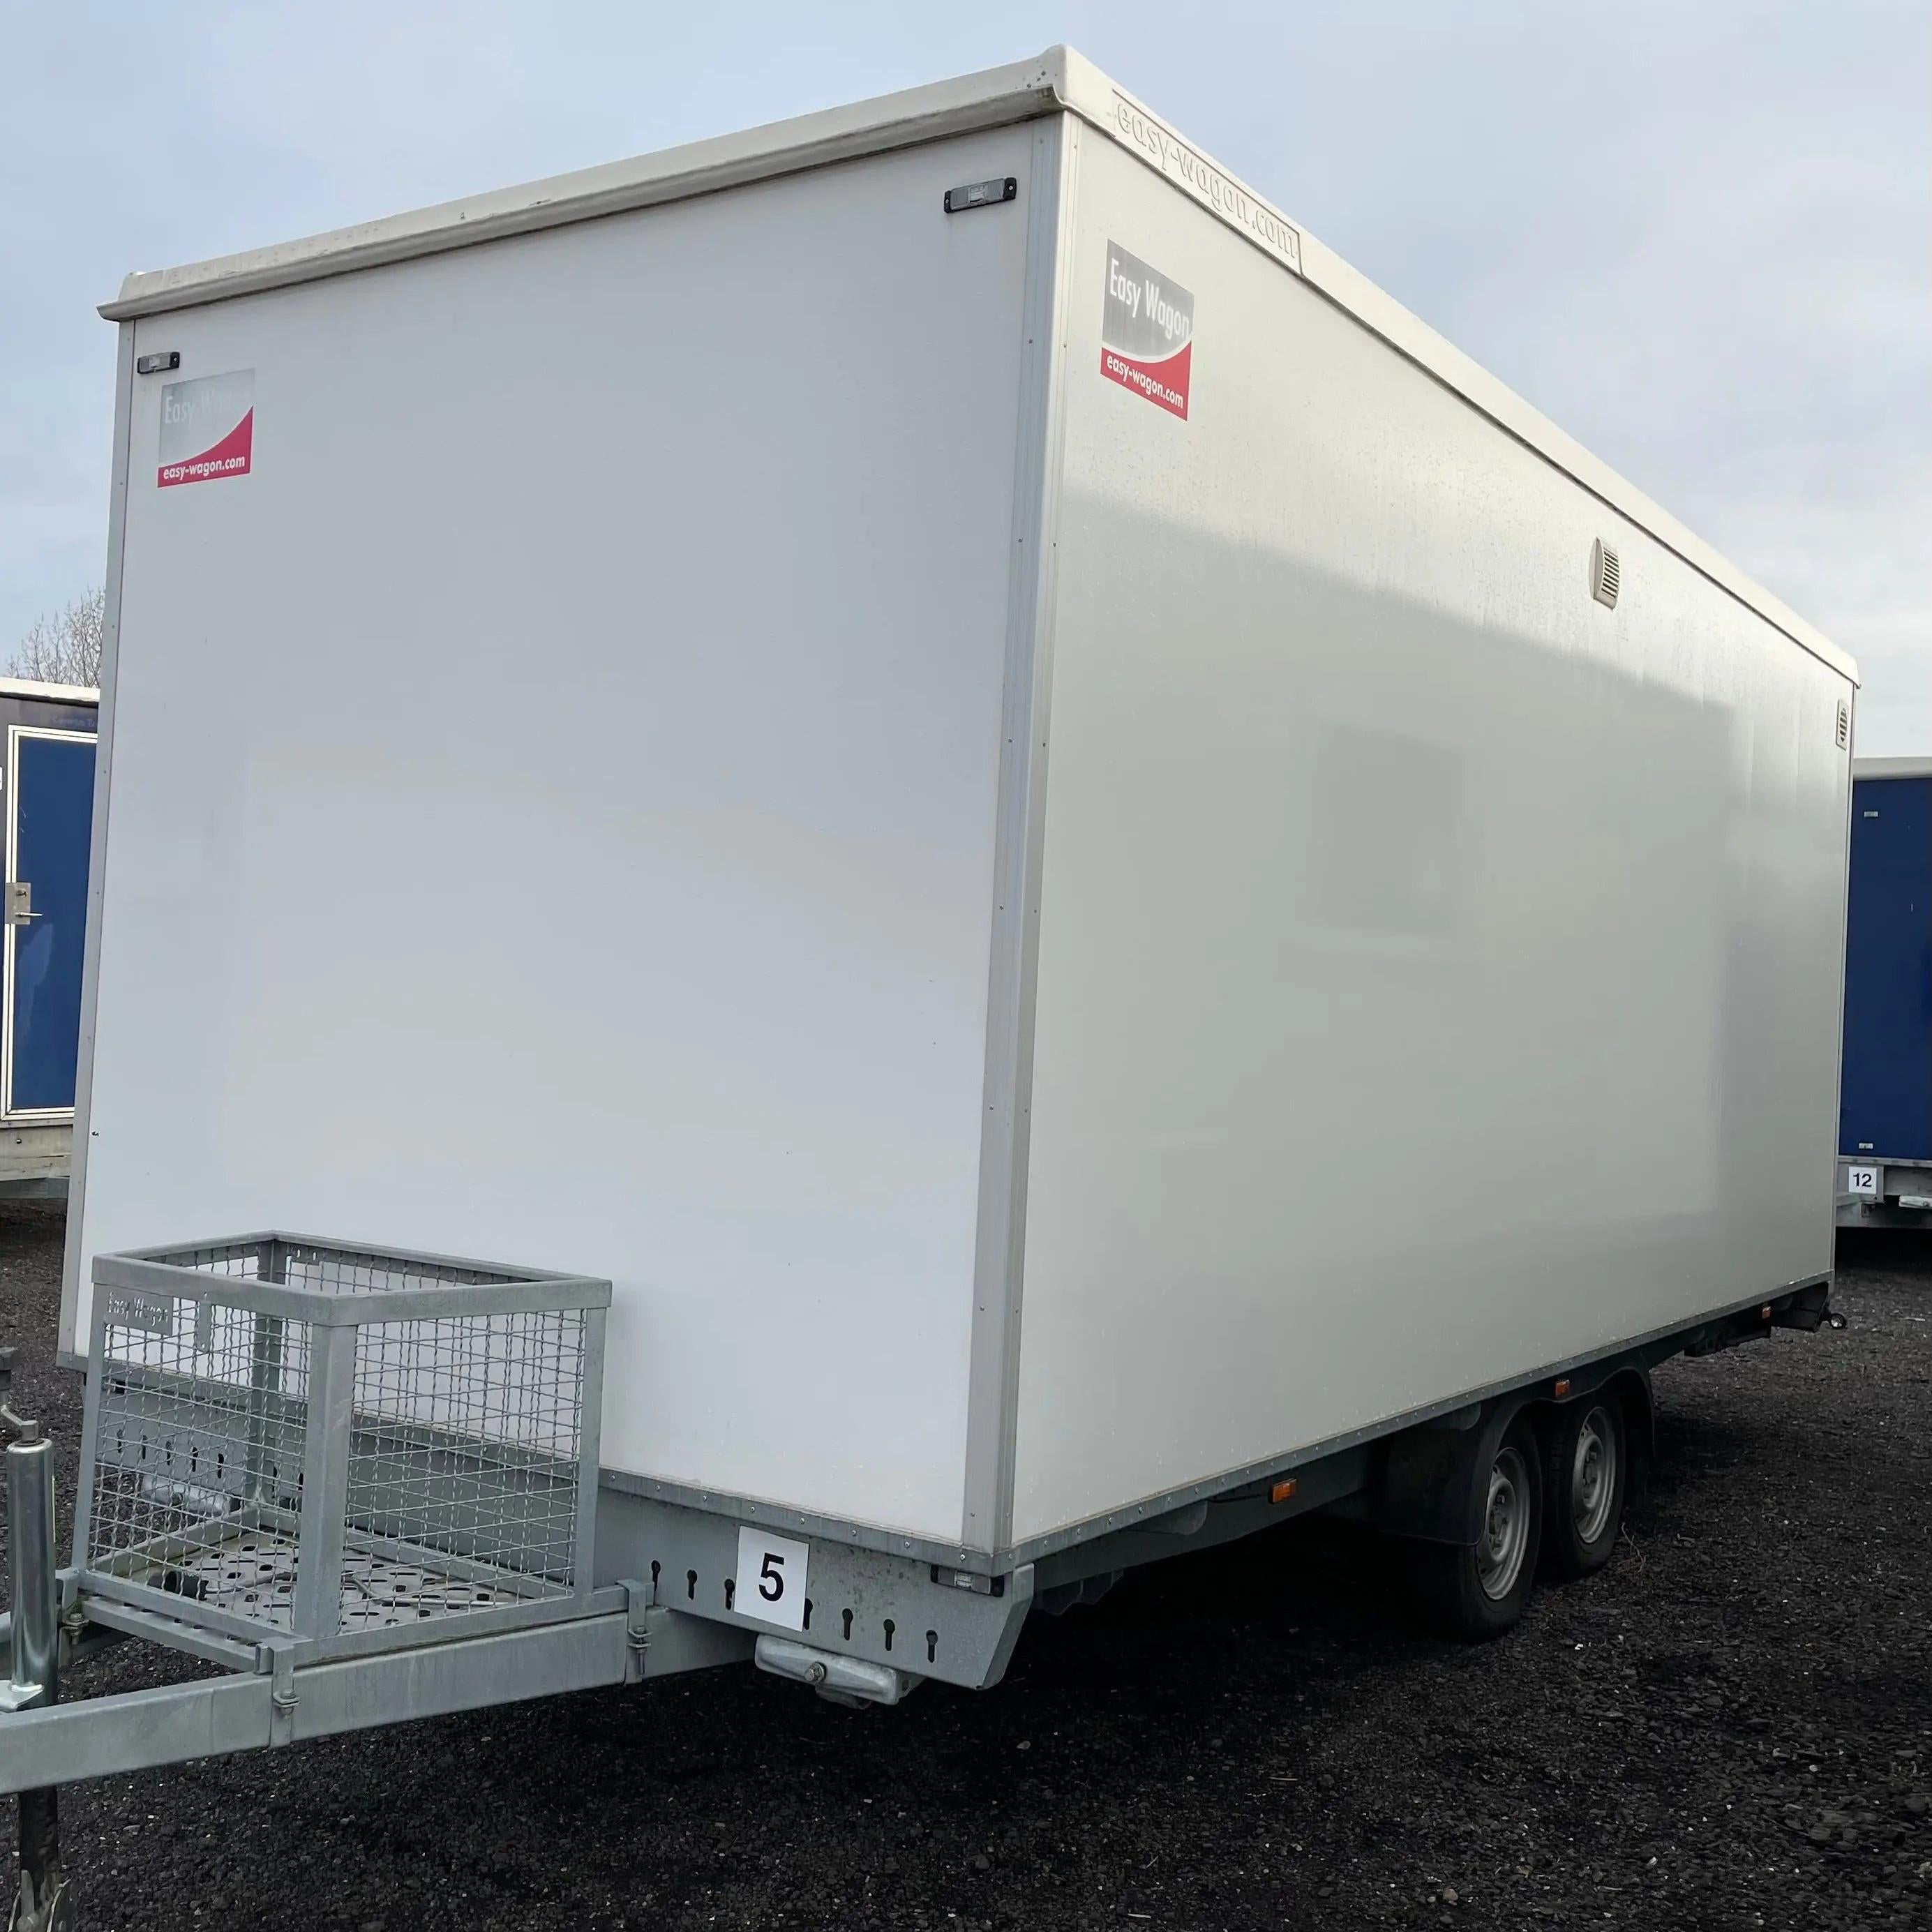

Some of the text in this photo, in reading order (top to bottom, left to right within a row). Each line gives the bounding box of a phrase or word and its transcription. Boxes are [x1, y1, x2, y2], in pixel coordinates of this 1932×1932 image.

[1116, 102, 1296, 259] easy-wagon.com
[1109, 257, 1190, 340] Easy Wagon
[1106, 354, 1184, 409] easy-wagon.com
[163, 456, 246, 481] easy-wagon.com
[1852, 1173, 1872, 1188] 12
[758, 1552, 784, 1602] 5
